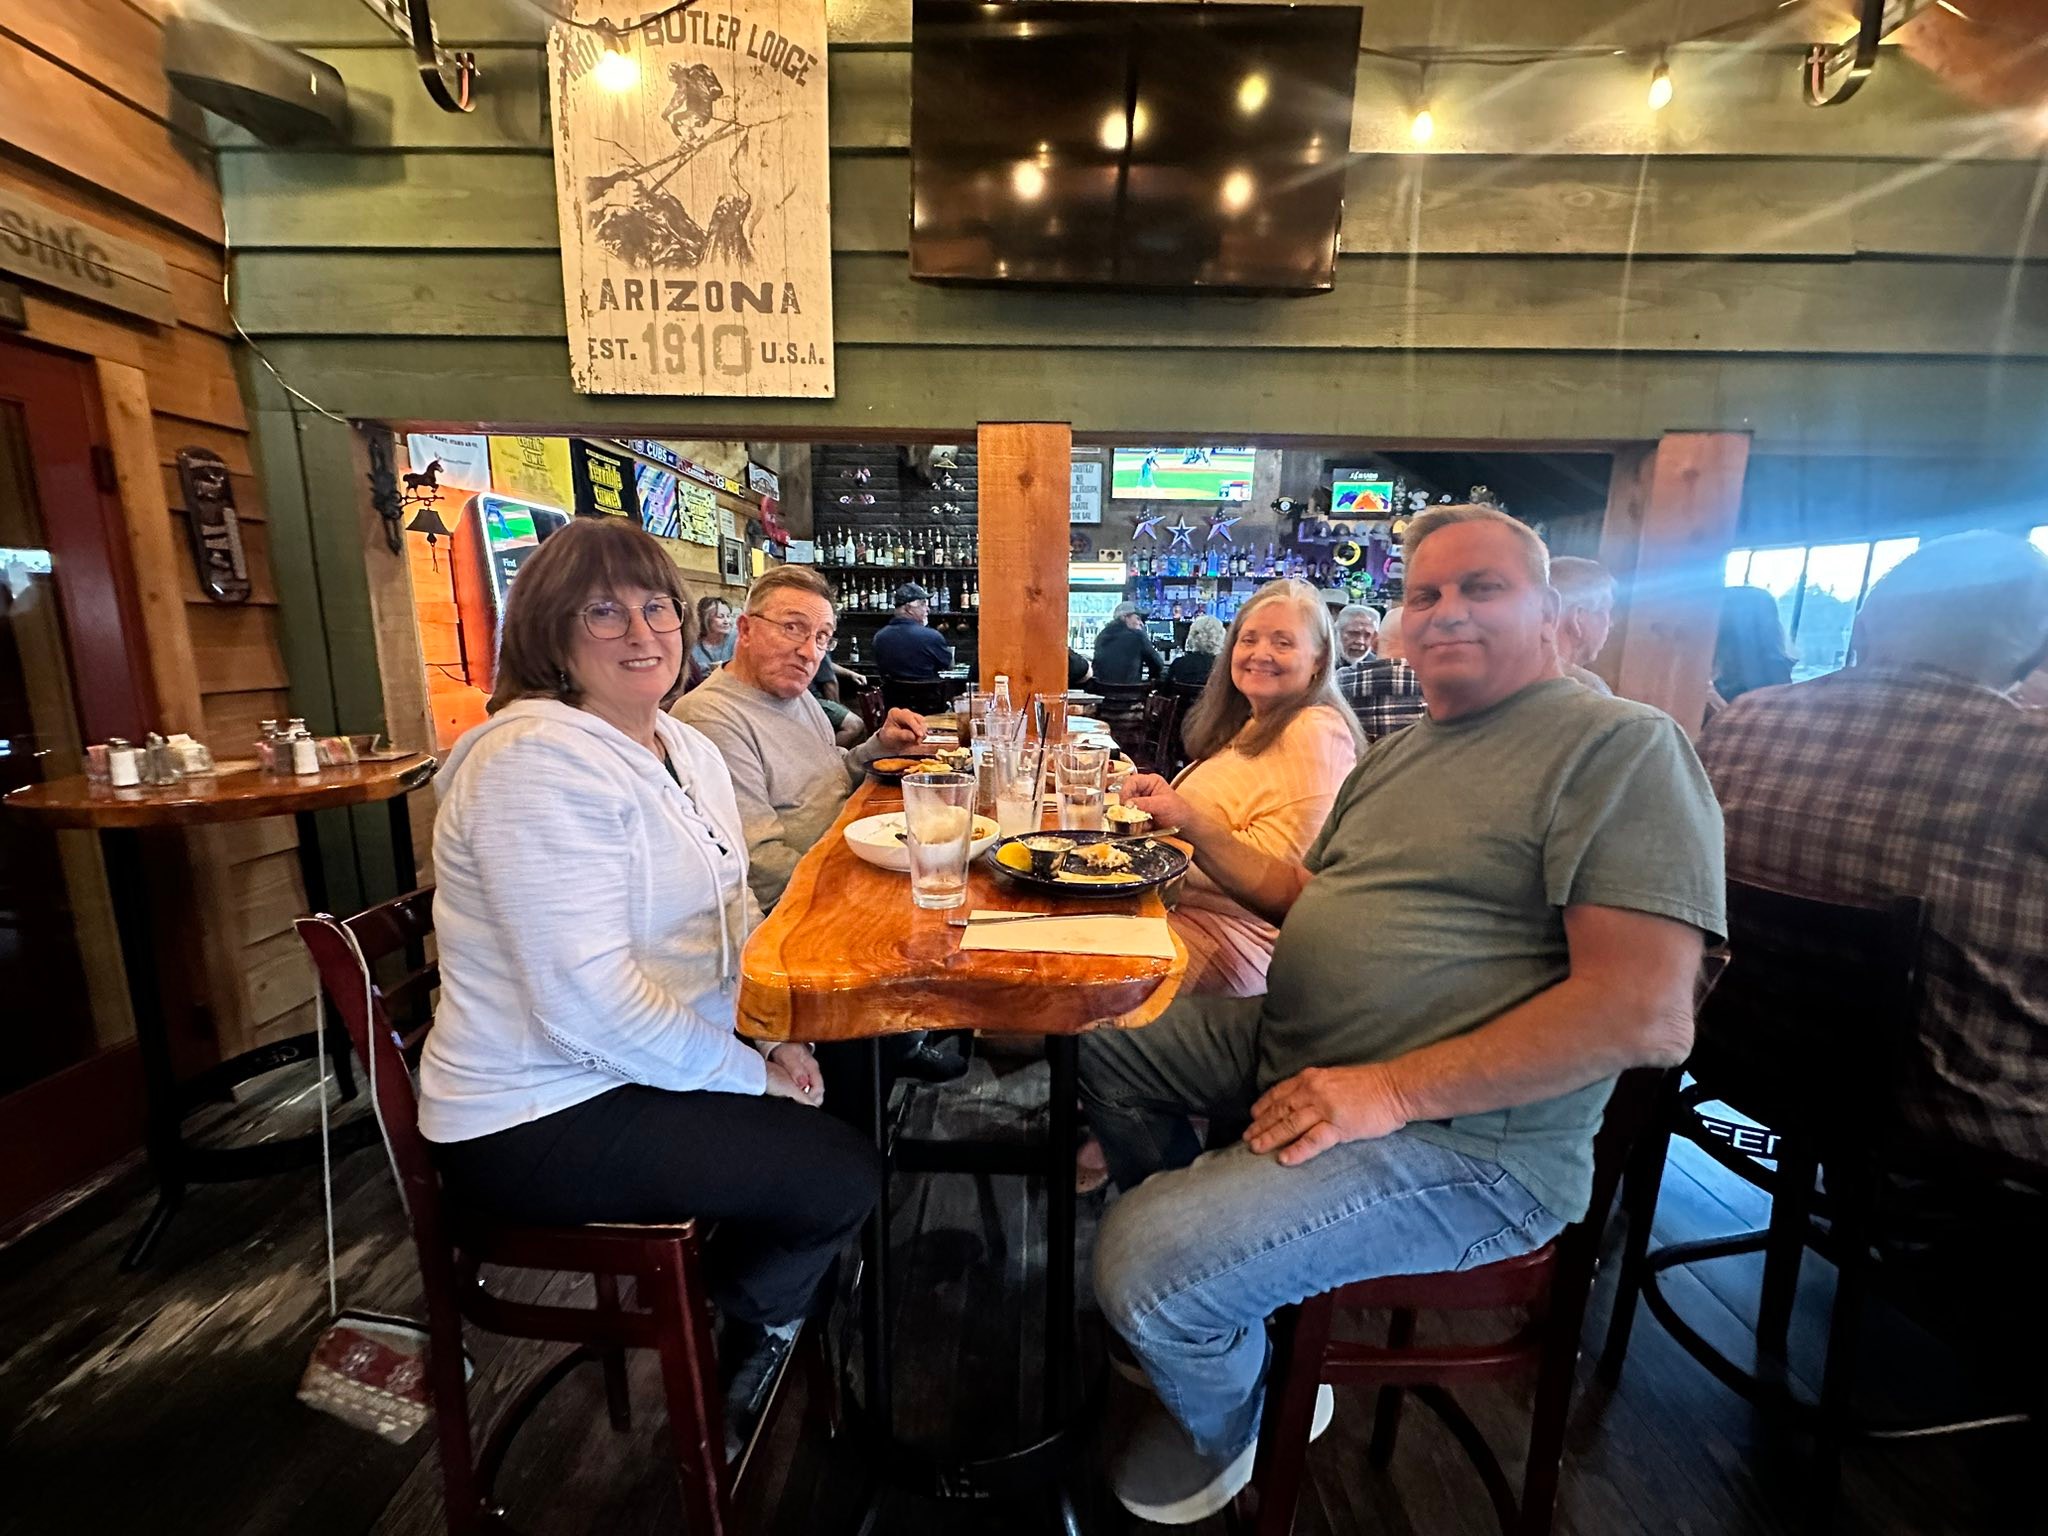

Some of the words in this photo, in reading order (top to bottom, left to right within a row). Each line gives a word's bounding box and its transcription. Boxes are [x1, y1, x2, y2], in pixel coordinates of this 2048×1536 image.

[640, 10, 741, 52] BUTLER
[746, 24, 818, 87] LODGE
[600, 278, 801, 314] ARIZONA
[588, 337, 638, 361] EST.
[641, 323, 753, 376] 1910
[761, 341, 825, 365] U.S.A.
[646, 442, 668, 462] CUBS
